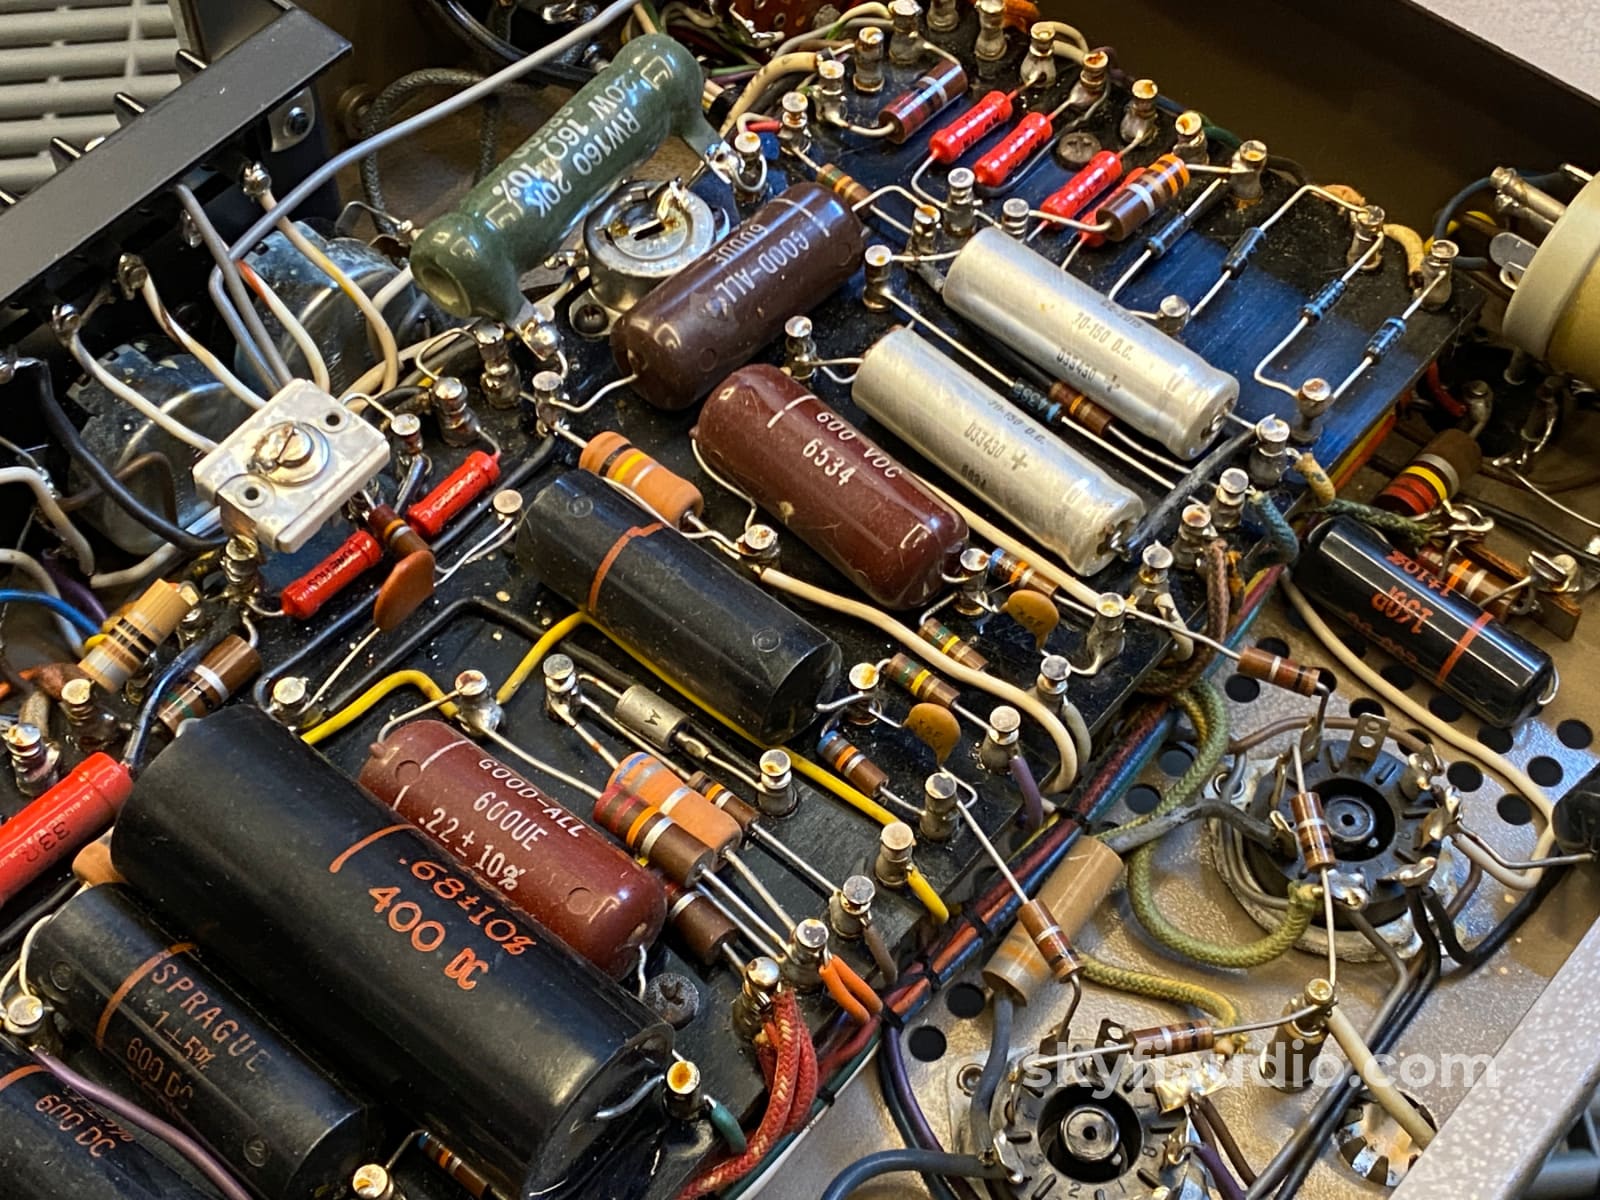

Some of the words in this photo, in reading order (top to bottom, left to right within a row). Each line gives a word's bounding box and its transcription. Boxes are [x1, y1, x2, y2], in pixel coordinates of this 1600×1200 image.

[544, 115, 591, 161] 16Ω
[572, 107, 641, 174] RW160
[493, 158, 542, 201] 10%
[714, 234, 810, 305] GOOD-ALL
[803, 439, 856, 486] 6534
[815, 412, 857, 441] 600
[865, 446, 901, 479] VDC
[1372, 585, 1434, 634] 160P
[472, 791, 548, 852] 600UE
[477, 757, 586, 838] GOOD-ALL
[369, 886, 445, 954] 400
[443, 947, 490, 990] DC
[149, 963, 271, 1073] SPRAGUE
[127, 1037, 168, 1082] 600
[35, 1093, 84, 1132] 600
[75, 1120, 116, 1157] DC
